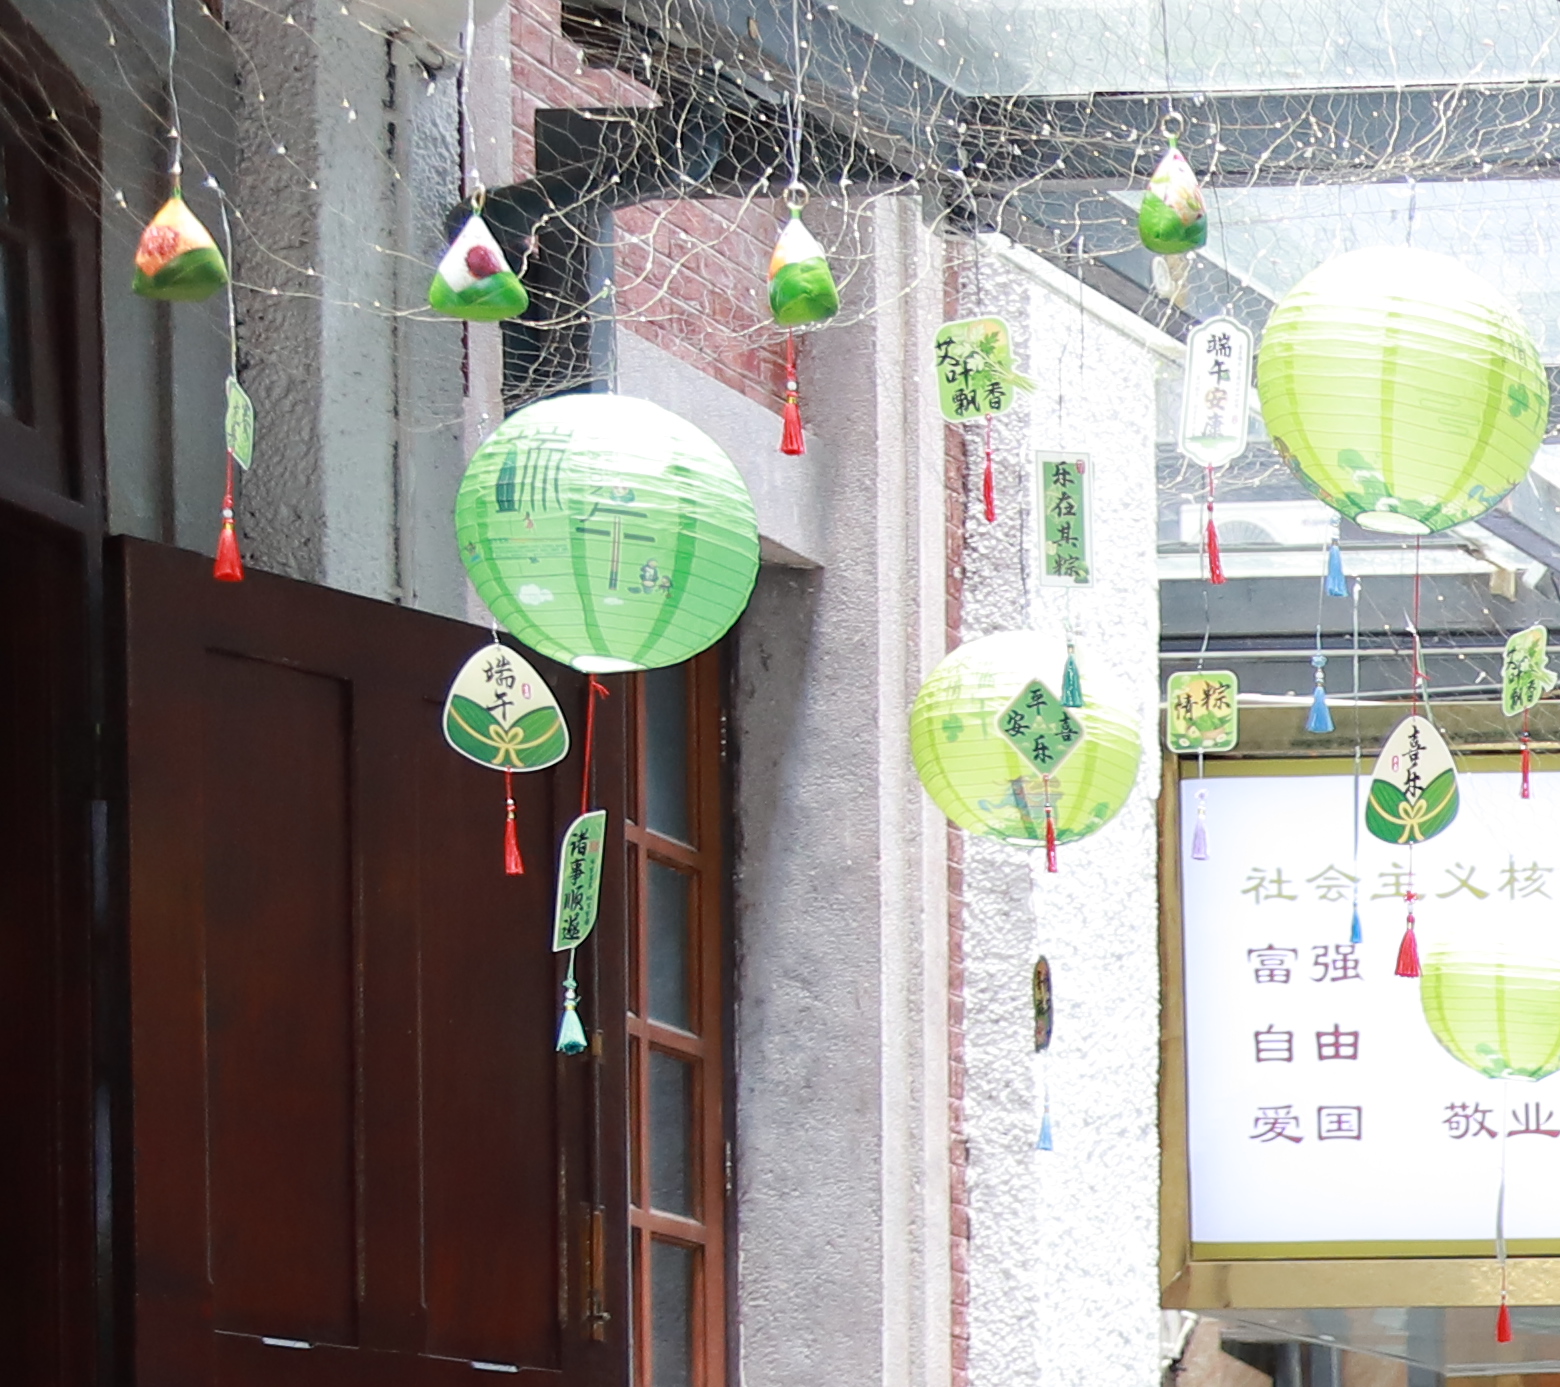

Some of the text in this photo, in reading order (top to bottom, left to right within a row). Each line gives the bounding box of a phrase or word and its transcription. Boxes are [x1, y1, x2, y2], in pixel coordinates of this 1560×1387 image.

[935, 336, 1006, 416] 艾叶飘香
[1201, 332, 1233, 439] 端午安康
[1051, 460, 1081, 579] 乐在其粽
[482, 655, 517, 722] 端午
[1402, 725, 1427, 799] 喜乐
[561, 828, 590, 941] 诸事顺遂
[1246, 943, 1366, 985] 富强
[1253, 1023, 1361, 1063] 自由
[1249, 1103, 1363, 1144] 爱国
